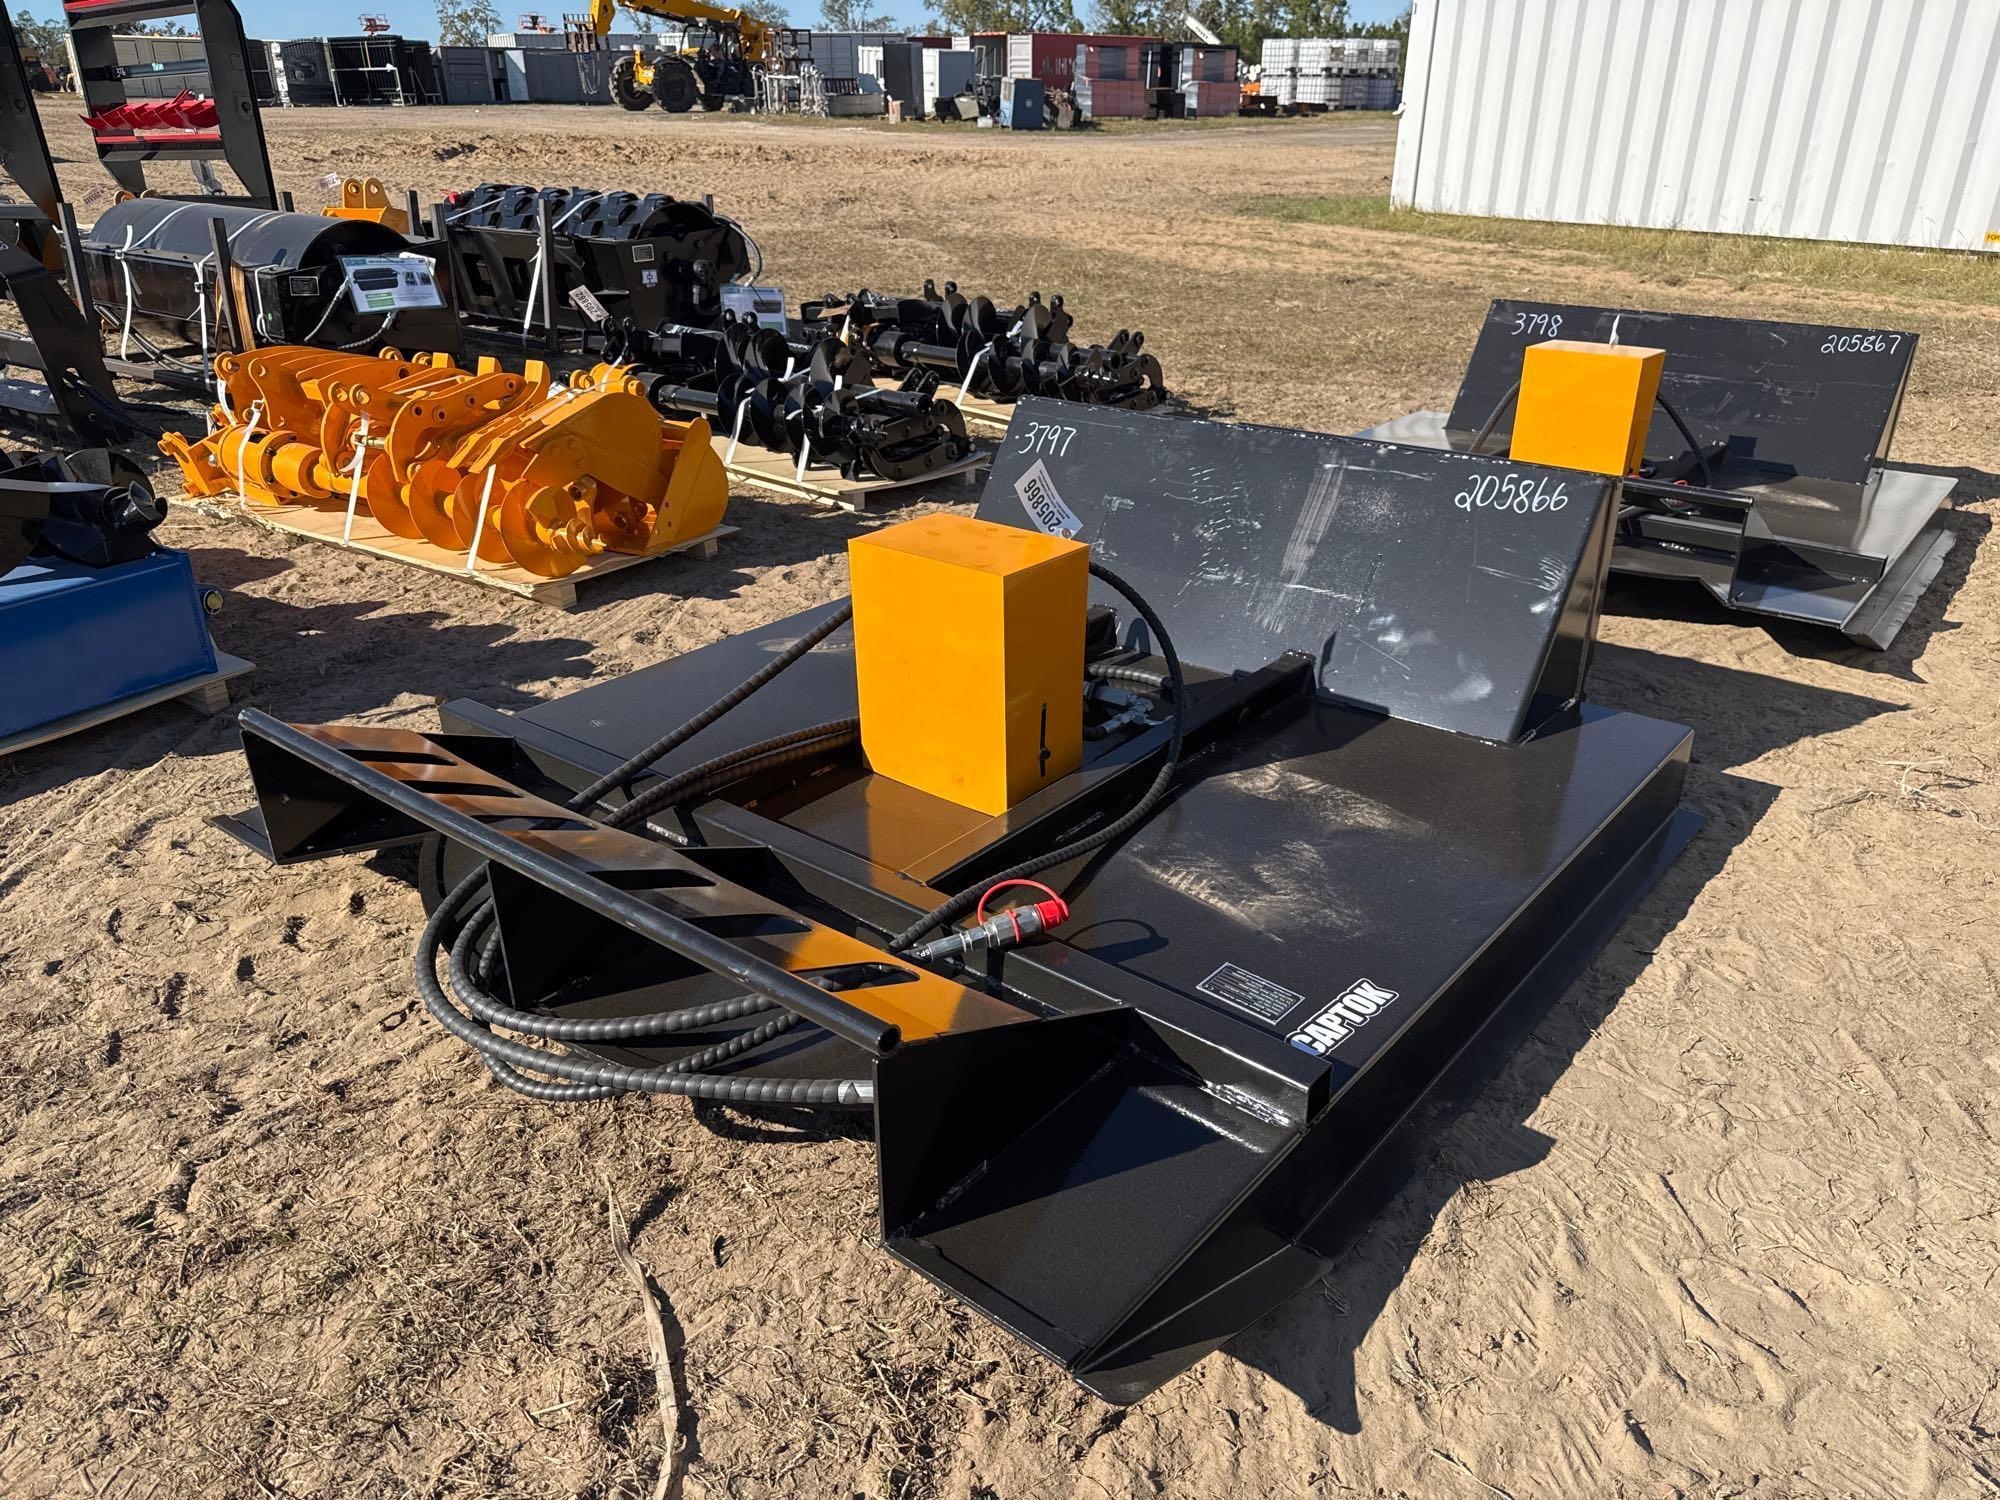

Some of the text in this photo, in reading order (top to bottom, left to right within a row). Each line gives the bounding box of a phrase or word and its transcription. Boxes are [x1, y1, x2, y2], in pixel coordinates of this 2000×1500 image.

[1511, 312, 1563, 337] 3798
[1820, 334, 1902, 355] 205867
[1018, 421, 1077, 457] 3797
[1023, 478, 1063, 533] 205866
[1454, 473, 1569, 514] 205866
[1290, 981, 1396, 1056] CAPTOK
